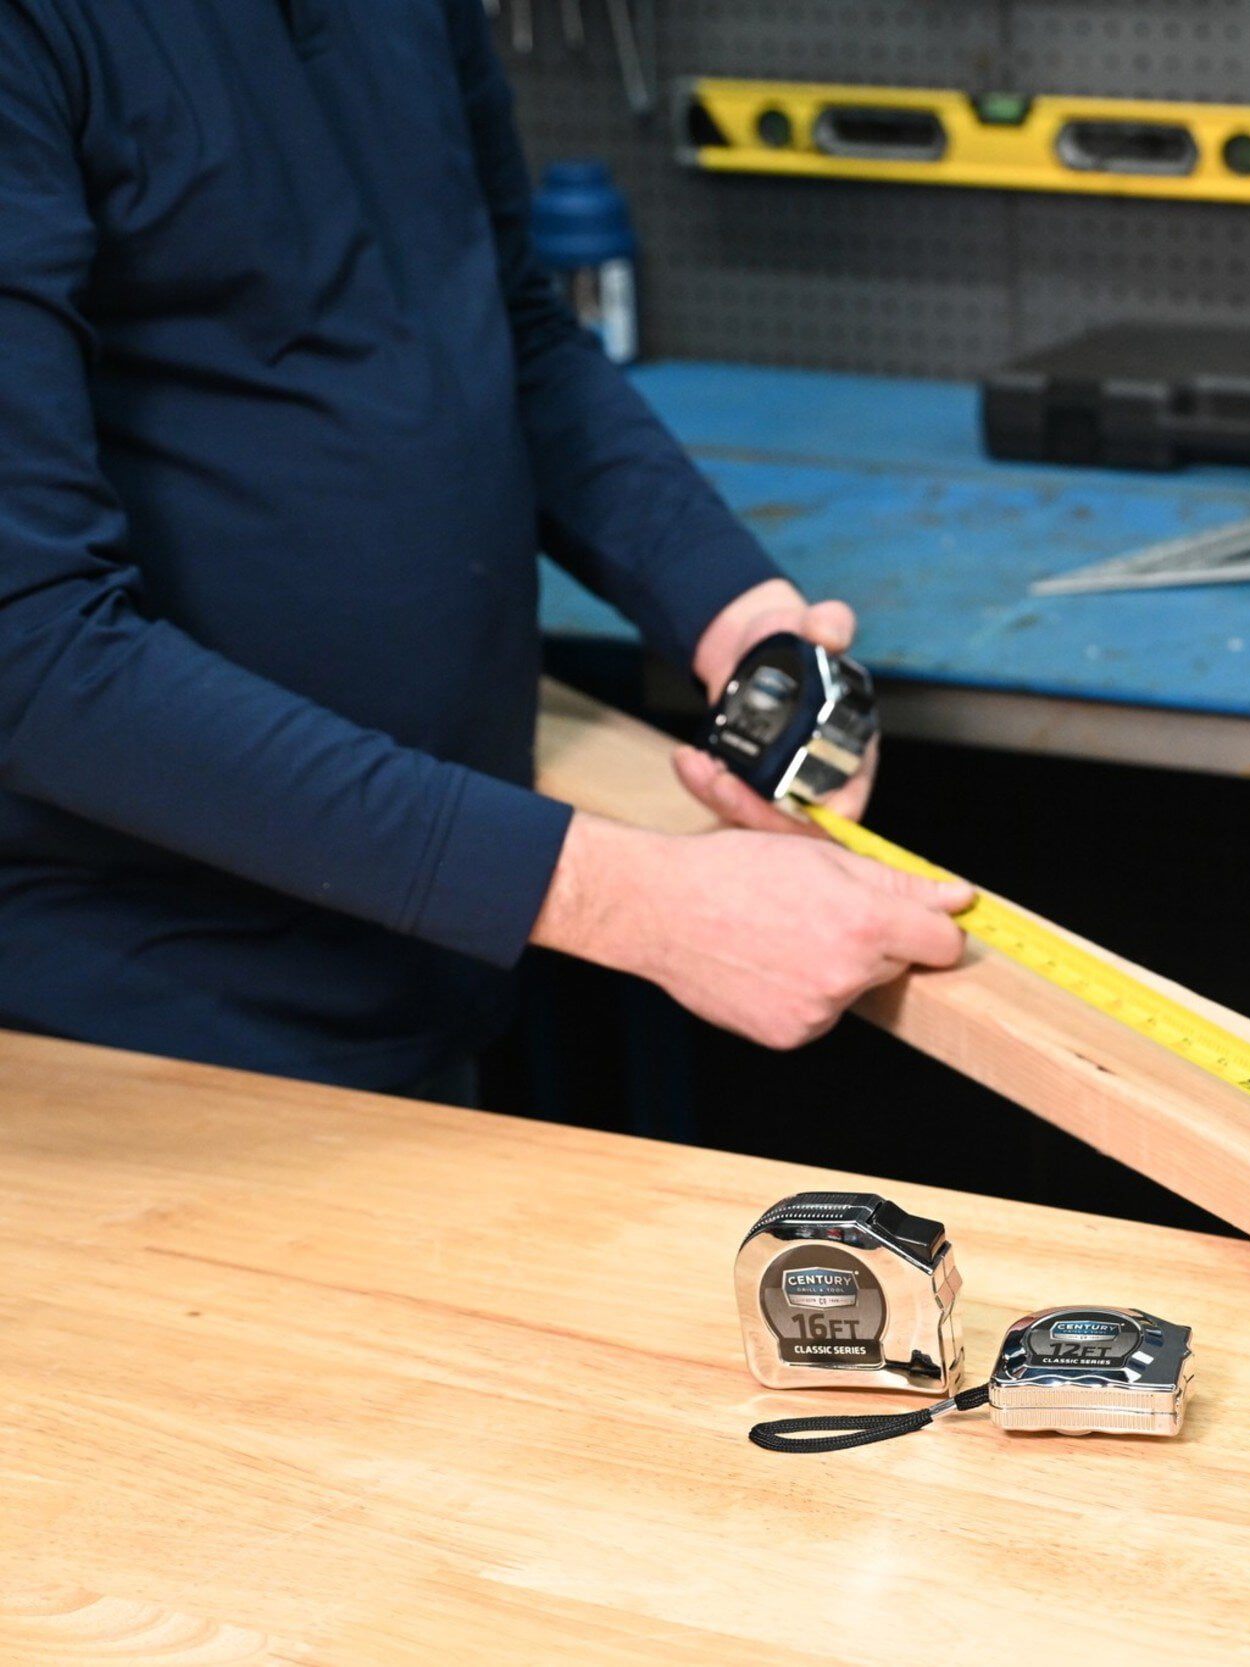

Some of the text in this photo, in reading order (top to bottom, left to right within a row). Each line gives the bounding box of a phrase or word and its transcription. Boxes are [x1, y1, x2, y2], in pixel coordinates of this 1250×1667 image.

[788, 1275, 852, 1286] CENTURY
[794, 1345, 867, 1355] CLASSIC SERIES
